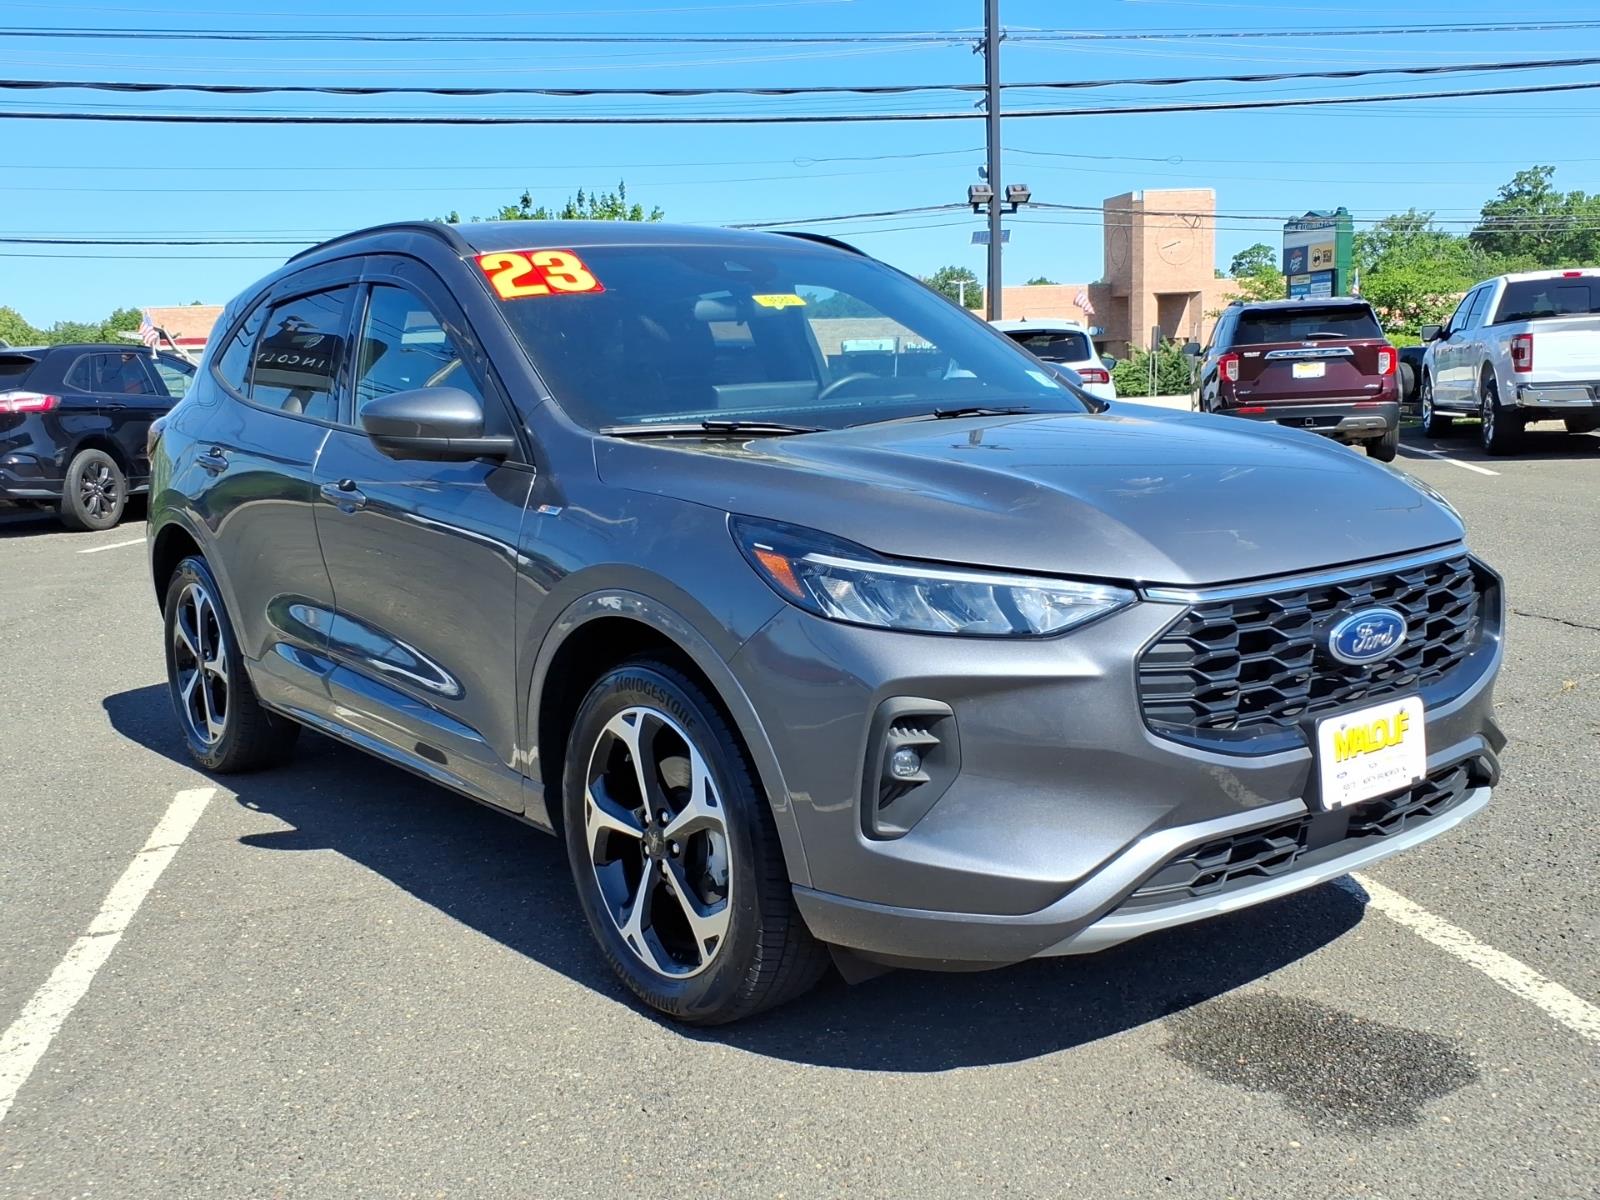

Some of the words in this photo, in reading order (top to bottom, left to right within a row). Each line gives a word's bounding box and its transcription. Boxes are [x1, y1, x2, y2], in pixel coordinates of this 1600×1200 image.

[480, 251, 597, 298] 23
[1353, 621, 1393, 653] Ford
[615, 676, 696, 729] BRIDGESTONE
[1334, 712, 1409, 763] MALOUF
